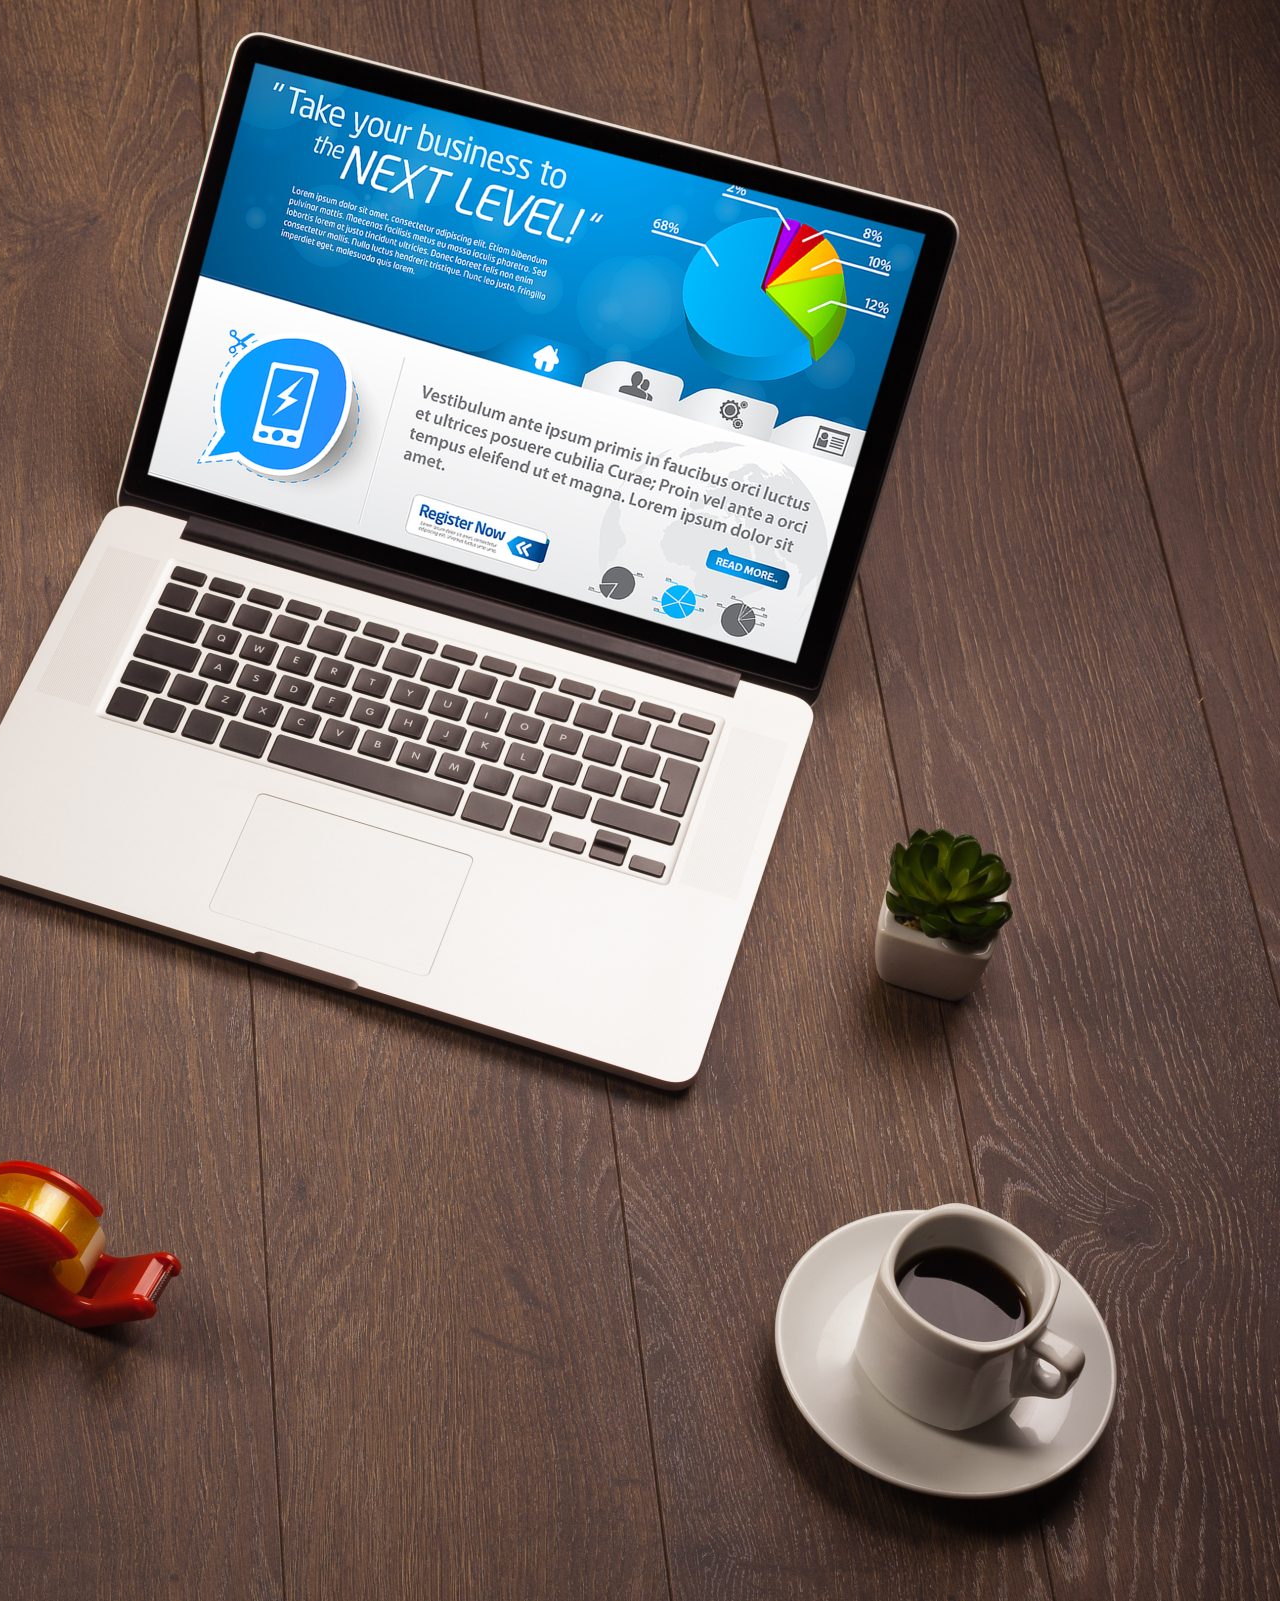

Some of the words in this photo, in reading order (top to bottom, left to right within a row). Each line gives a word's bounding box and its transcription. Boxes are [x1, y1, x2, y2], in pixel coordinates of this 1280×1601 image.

[314, 136, 345, 159] the
[340, 145, 454, 204] NEXT
[348, 111, 413, 145] your
[416, 123, 533, 180] business
[540, 160, 567, 189] to
[280, 229, 316, 246] imperdiet
[335, 246, 376, 263] malesuada
[376, 258, 392, 268] quis
[392, 261, 415, 275] lorem.
[282, 219, 327, 237] consectetur
[326, 232, 350, 244] mollis.
[351, 237, 371, 250] Nulla
[371, 243, 394, 257] luctus
[394, 250, 429, 267] hendrerit
[429, 261, 462, 277] tristique.
[463, 269, 483, 282] Nunc
[483, 275, 496, 286] leo
[517, 285, 546, 301] fringilla
[286, 207, 314, 222] lobortis
[314, 216, 336, 228] lorem
[336, 223, 345, 232] at
[344, 224, 364, 237] justo
[364, 230, 398, 247] tincidunt
[398, 241, 429, 256] ultricies.
[430, 249, 454, 263] Donec
[454, 255, 482, 271] laoreet
[482, 263, 499, 275] felis
[499, 270, 514, 280] non
[514, 274, 534, 285] enim
[288, 198, 319, 212] pulvinar
[319, 207, 344, 219] mattis.
[345, 213, 384, 231] Maecenas
[384, 223, 412, 239] facilisis
[412, 233, 436, 246] metus
[436, 240, 447, 249] eu
[447, 243, 472, 256] massa
[472, 249, 496, 263] iaculis
[495, 257, 530, 273] pharetra.
[531, 266, 548, 278] Sed
[291, 185, 315, 199] Lorem
[315, 192, 338, 206] ipsum
[338, 200, 358, 211] dolor
[358, 205, 369, 215] sit
[391, 215, 435, 233] consectetur
[435, 228, 473, 246] adipiscing
[473, 239, 487, 249] elit.
[488, 242, 510, 255] Etiam
[510, 248, 548, 266] bibendum
[653, 218, 680, 235] 68%
[863, 228, 883, 243] 8%
[868, 256, 891, 272] 10%
[865, 297, 889, 314] 12%
[403, 450, 445, 471] amet.
[415, 409, 432, 423] et
[433, 414, 489, 439] ultrices
[489, 431, 552, 458] posuere
[554, 451, 605, 474] cubilia
[607, 464, 657, 491] Curae;
[658, 478, 700, 502] Proin
[703, 494, 727, 510] vel
[727, 502, 763, 521] ante
[764, 513, 775, 525] a
[777, 517, 809, 534] orci
[422, 384, 506, 422] Vestibulum
[508, 414, 543, 433] ante
[545, 421, 592, 448] ipsum
[593, 439, 643, 463] primis
[645, 451, 660, 468] in
[662, 456, 729, 488] faucibus
[730, 480, 762, 498] orci
[762, 485, 811, 512] luctus
[409, 427, 466, 455] tempus
[468, 446, 531, 474] eleifend
[532, 466, 550, 480] ut
[551, 472, 568, 486] et
[569, 477, 625, 503] magna.
[628, 492, 678, 518] Lorem
[680, 507, 728, 533] ipsum
[730, 523, 773, 546] dolor
[773, 537, 794, 553] sit
[419, 504, 473, 530] Register
[474, 521, 506, 541] Now
[715, 557, 743, 572] READ
[213, 663, 222, 671] A
[251, 674, 260, 682] S
[289, 684, 298, 693] D
[365, 707, 374, 716] G
[403, 717, 413, 727] H
[442, 730, 450, 738] J
[480, 740, 489, 750] K
[216, 633, 226, 642] Q
[253, 644, 265, 653] W
[292, 655, 300, 664] E
[330, 666, 338, 675] R
[369, 677, 376, 686] T
[406, 688, 414, 697] Y
[442, 699, 452, 708] U
[519, 722, 529, 731] O
[558, 733, 567, 741] P
[220, 694, 230, 704] Z
[257, 706, 268, 715] X
[296, 717, 305, 726] C
[336, 728, 344, 737] V
[373, 739, 381, 748] B
[410, 750, 421, 760] N
[448, 762, 460, 772] M
